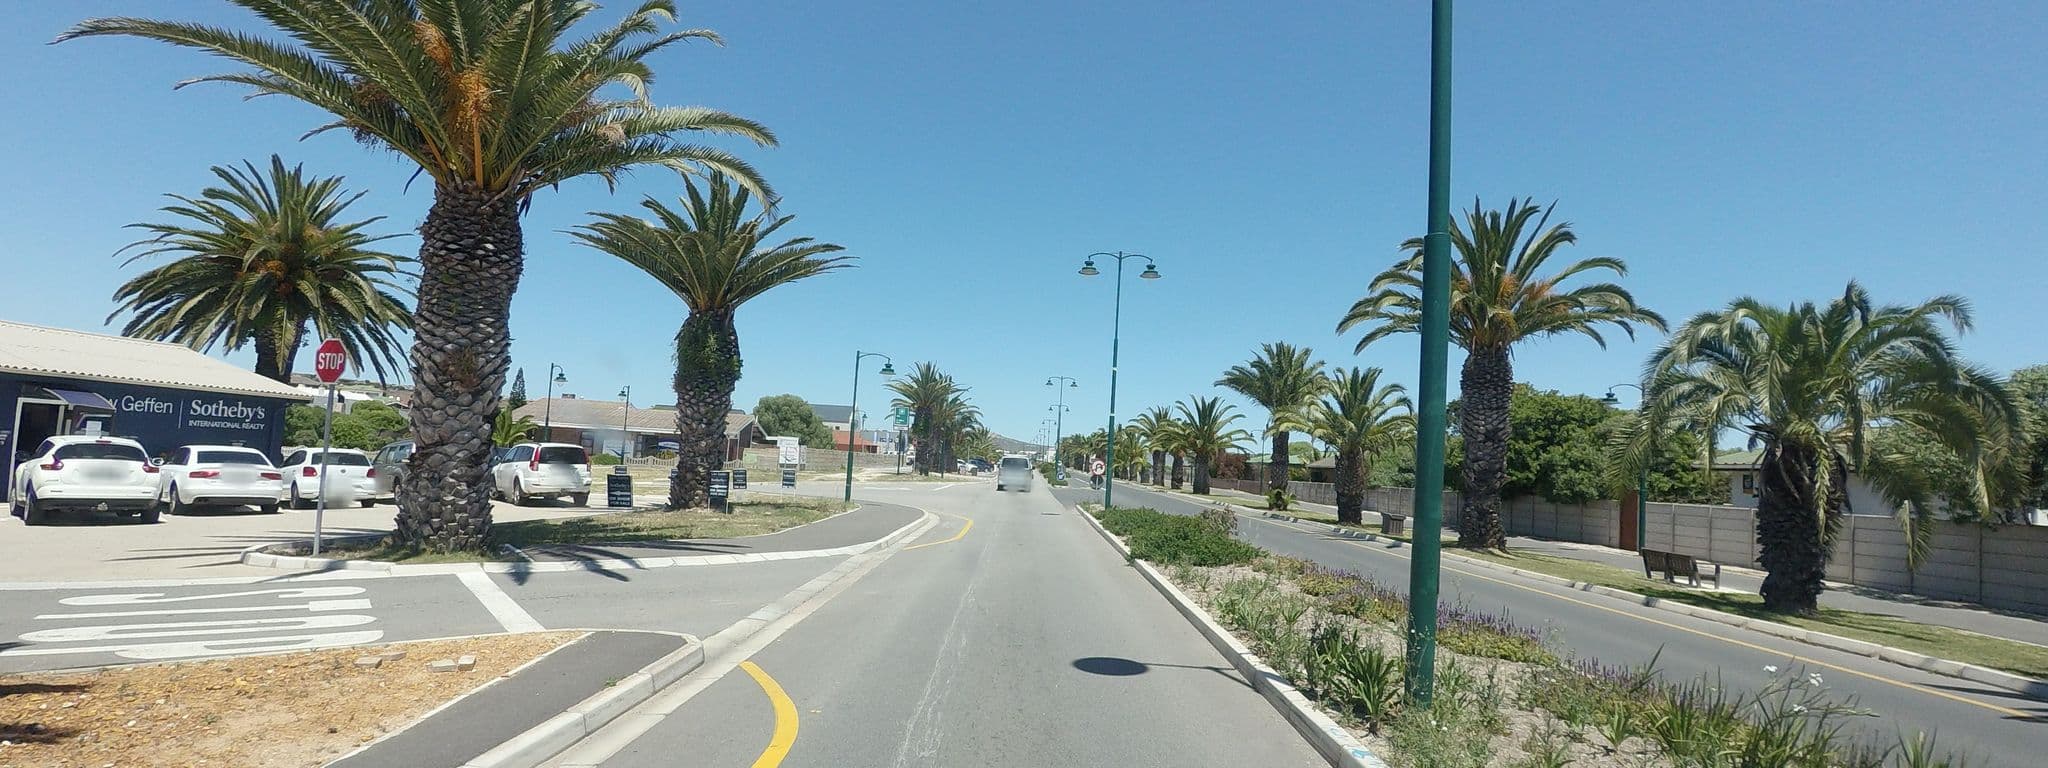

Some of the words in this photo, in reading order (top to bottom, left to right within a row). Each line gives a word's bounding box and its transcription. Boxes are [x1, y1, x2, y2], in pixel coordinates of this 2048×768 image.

[318, 353, 344, 370] STOP
[121, 395, 173, 414] Geffen
[189, 399, 265, 421] Sotheby's
[188, 420, 241, 429] INTERNATIONAL
[242, 422, 265, 430] REALTY
